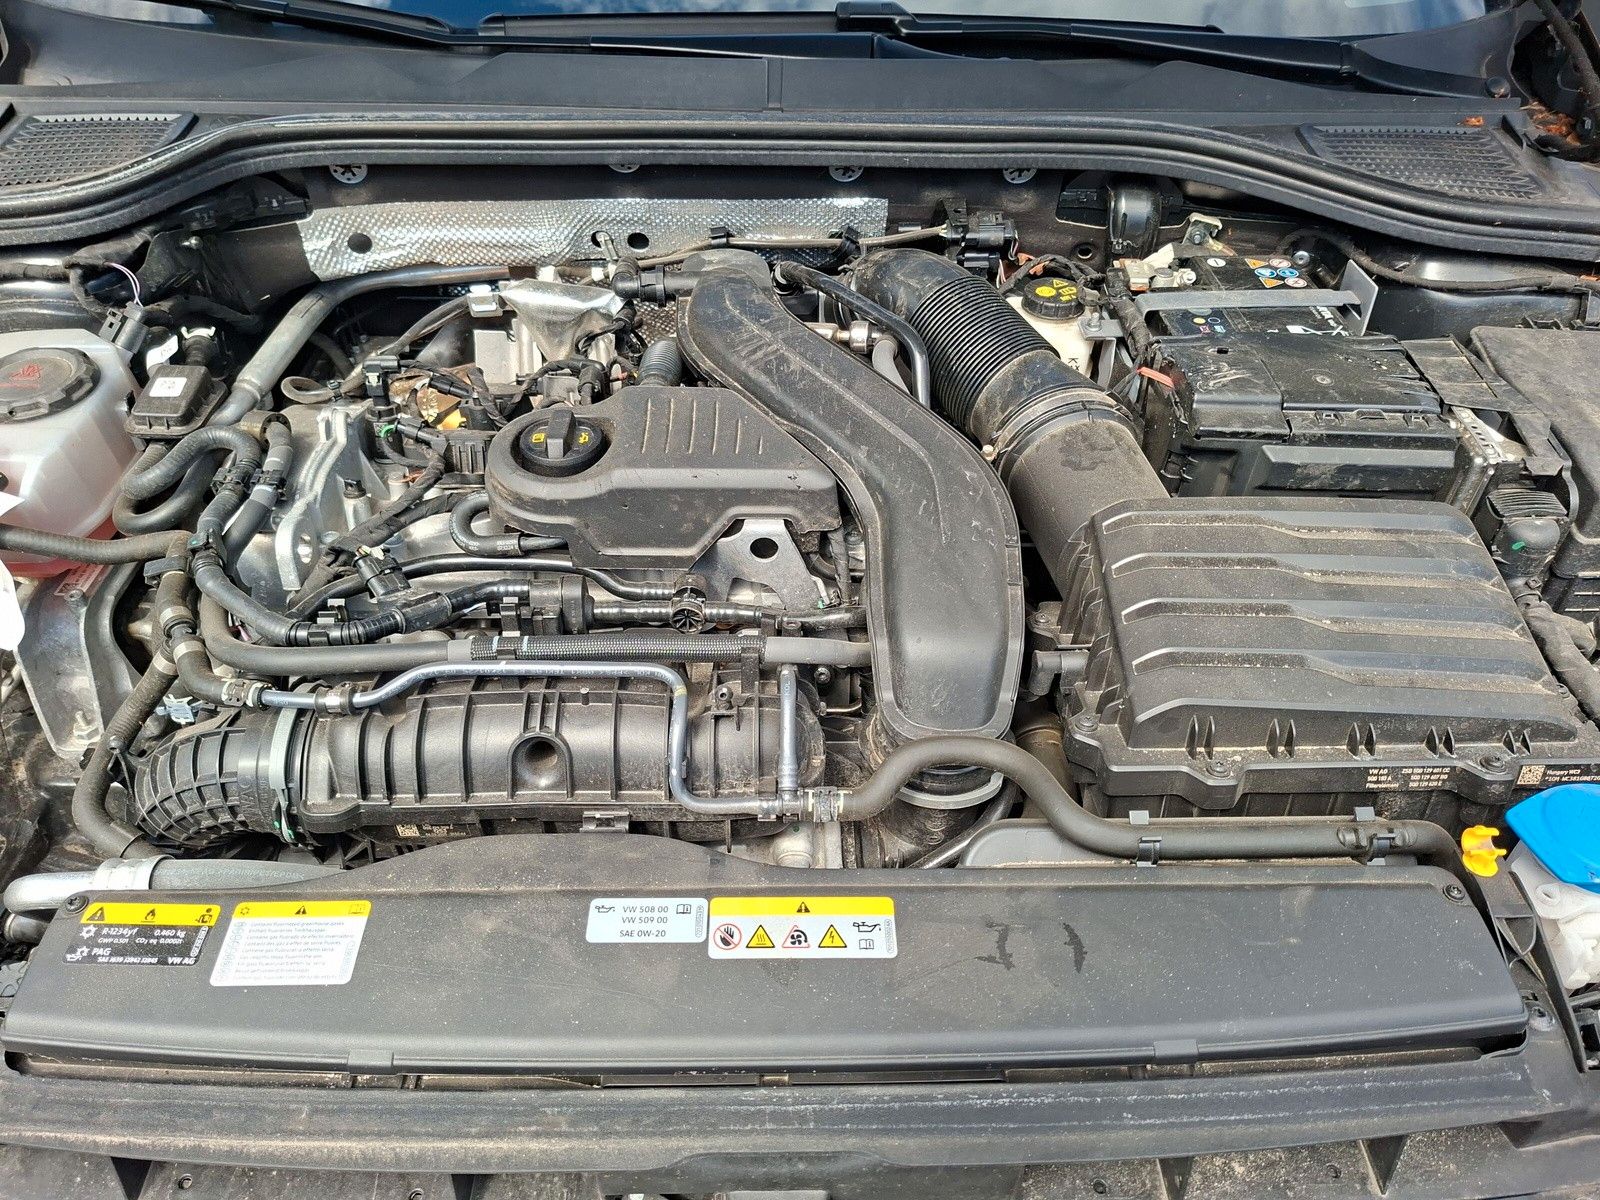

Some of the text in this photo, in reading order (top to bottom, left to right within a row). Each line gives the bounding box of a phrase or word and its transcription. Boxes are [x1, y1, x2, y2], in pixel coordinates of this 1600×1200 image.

[622, 905, 669, 913] VW 508 00
[621, 916, 668, 924] VW 509 00
[101, 927, 139, 938] R-1234yf
[176, 929, 187, 938] kg
[619, 929, 667, 938] SAE 0W-20
[91, 947, 112, 956] PAG
[167, 956, 196, 965] VW AG
